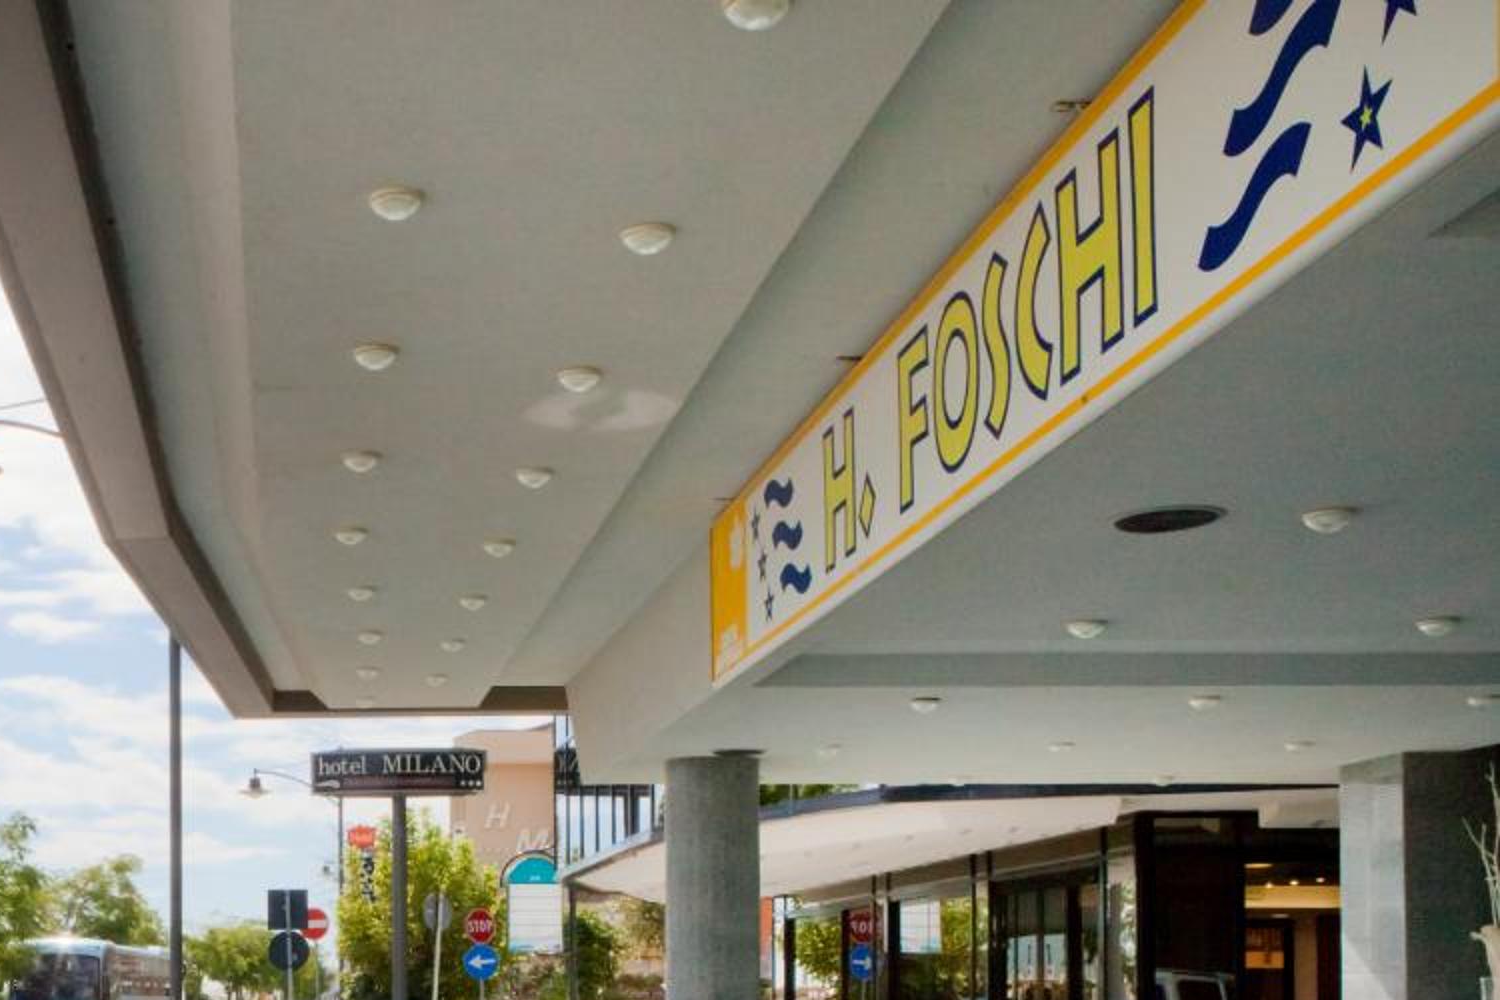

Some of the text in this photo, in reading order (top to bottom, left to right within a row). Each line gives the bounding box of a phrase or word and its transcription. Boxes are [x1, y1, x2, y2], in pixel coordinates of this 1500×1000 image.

[896, 84, 1158, 516] FOSCHI
[318, 753, 482, 775] hotel MILANO
[467, 919, 493, 935] STOP
